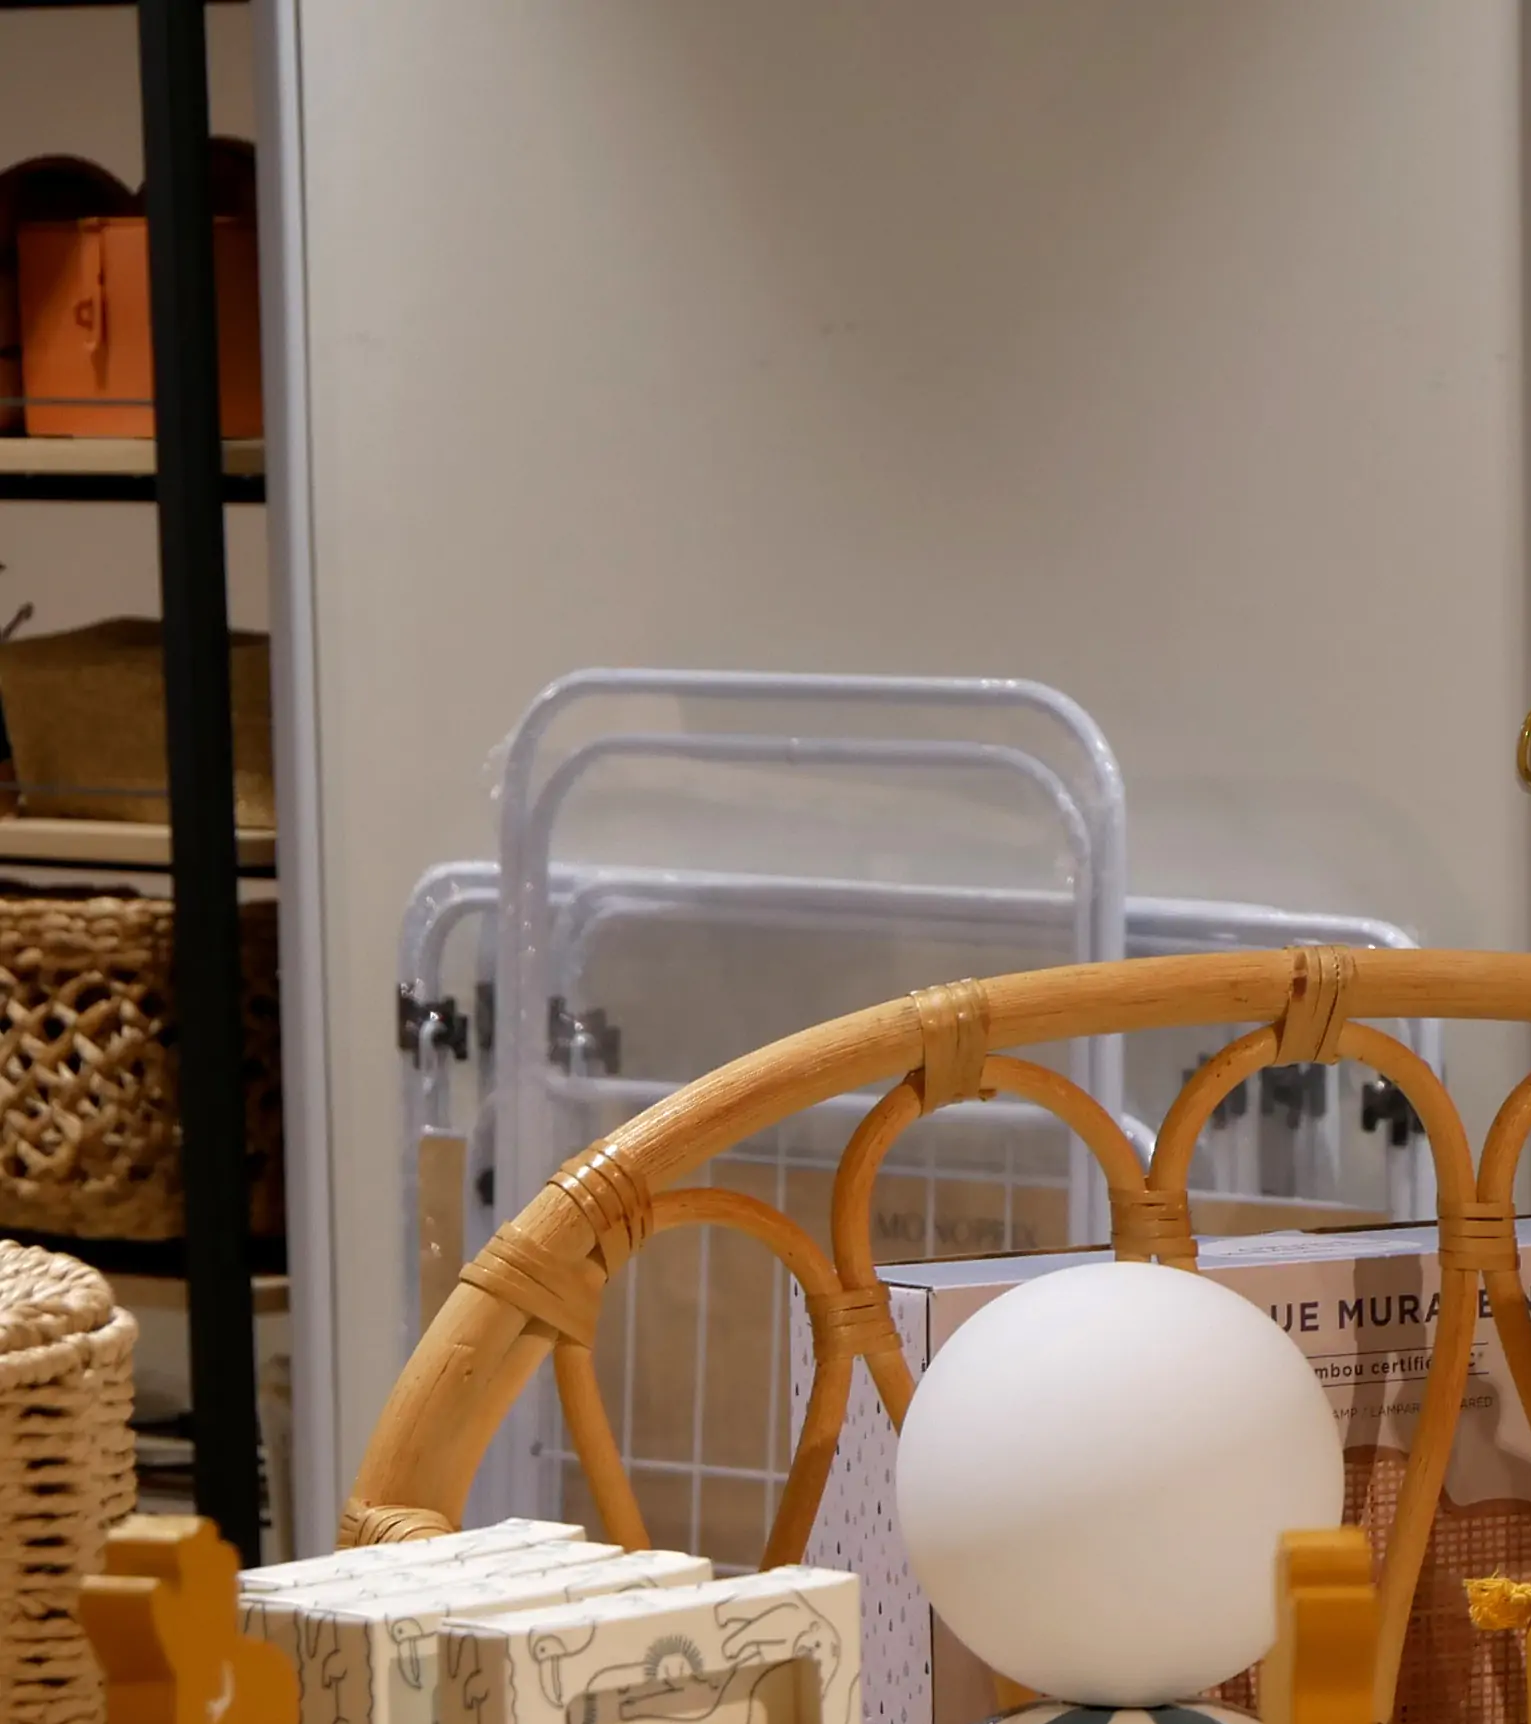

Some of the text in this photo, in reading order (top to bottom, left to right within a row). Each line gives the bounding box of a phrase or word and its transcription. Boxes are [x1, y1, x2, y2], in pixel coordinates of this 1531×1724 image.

[1270, 1301, 1319, 1333] UE
[1338, 1289, 1494, 1330] MURAE
[1314, 1362, 1364, 1380] mbou
[1460, 1396, 1494, 1410] ARED
